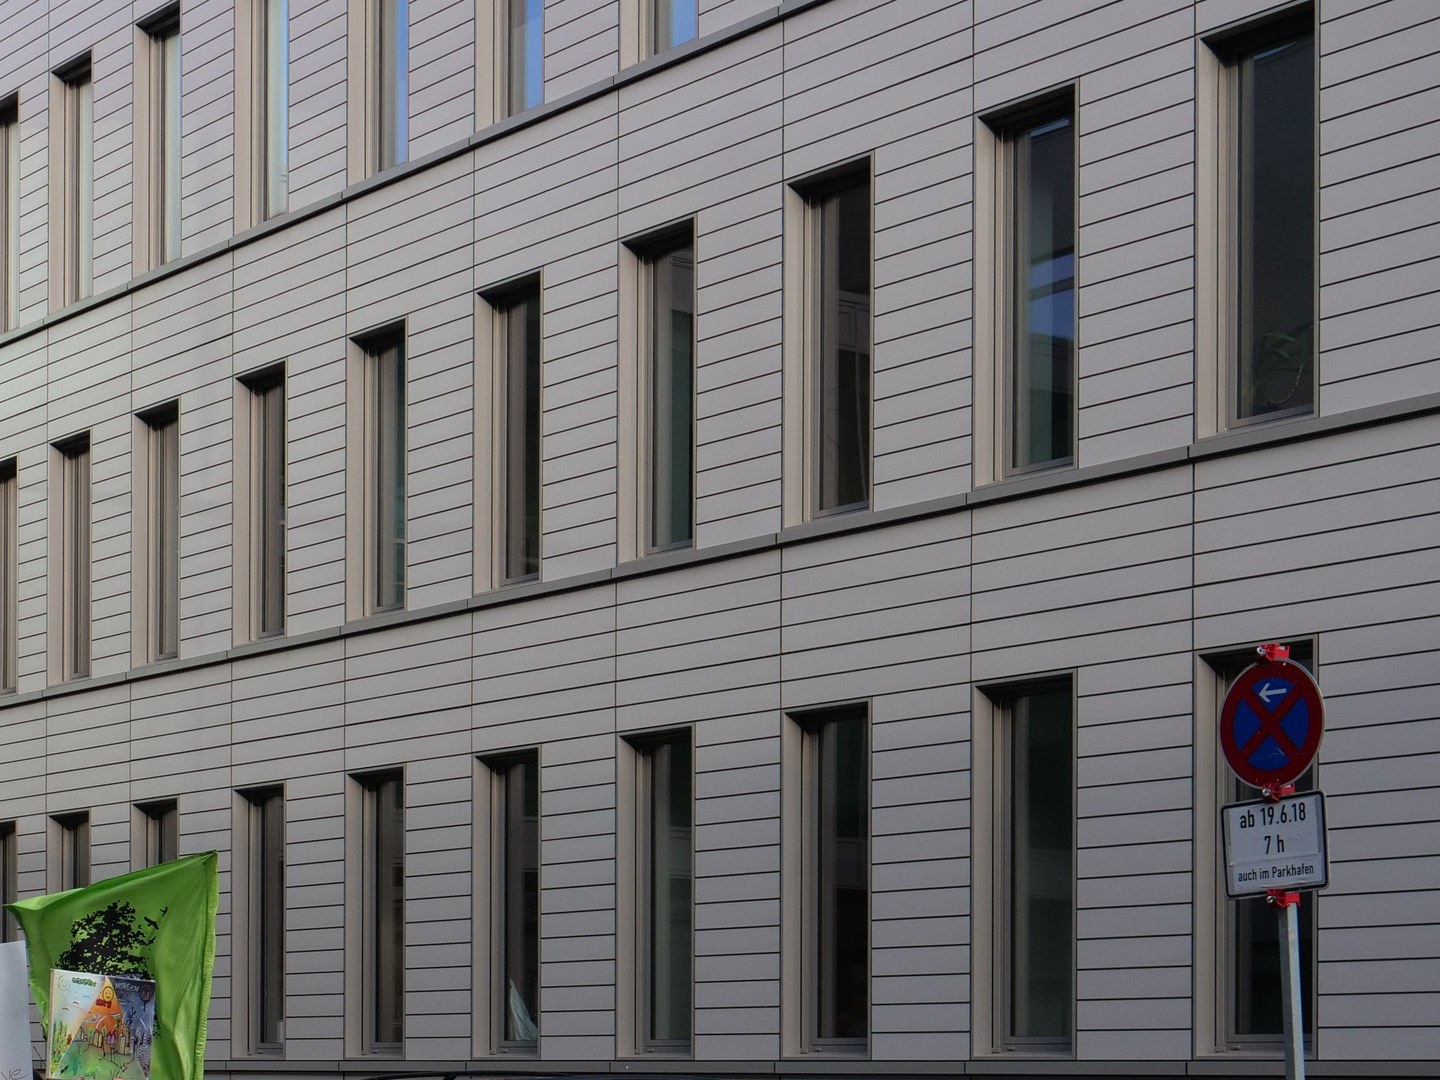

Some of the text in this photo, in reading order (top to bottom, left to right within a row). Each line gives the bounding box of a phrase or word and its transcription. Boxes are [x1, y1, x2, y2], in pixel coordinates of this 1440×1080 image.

[1240, 802, 1306, 829] ab 19.6.18
[1264, 834, 1285, 854] 7 h
[1238, 863, 1314, 882] auch im Parkhafen
